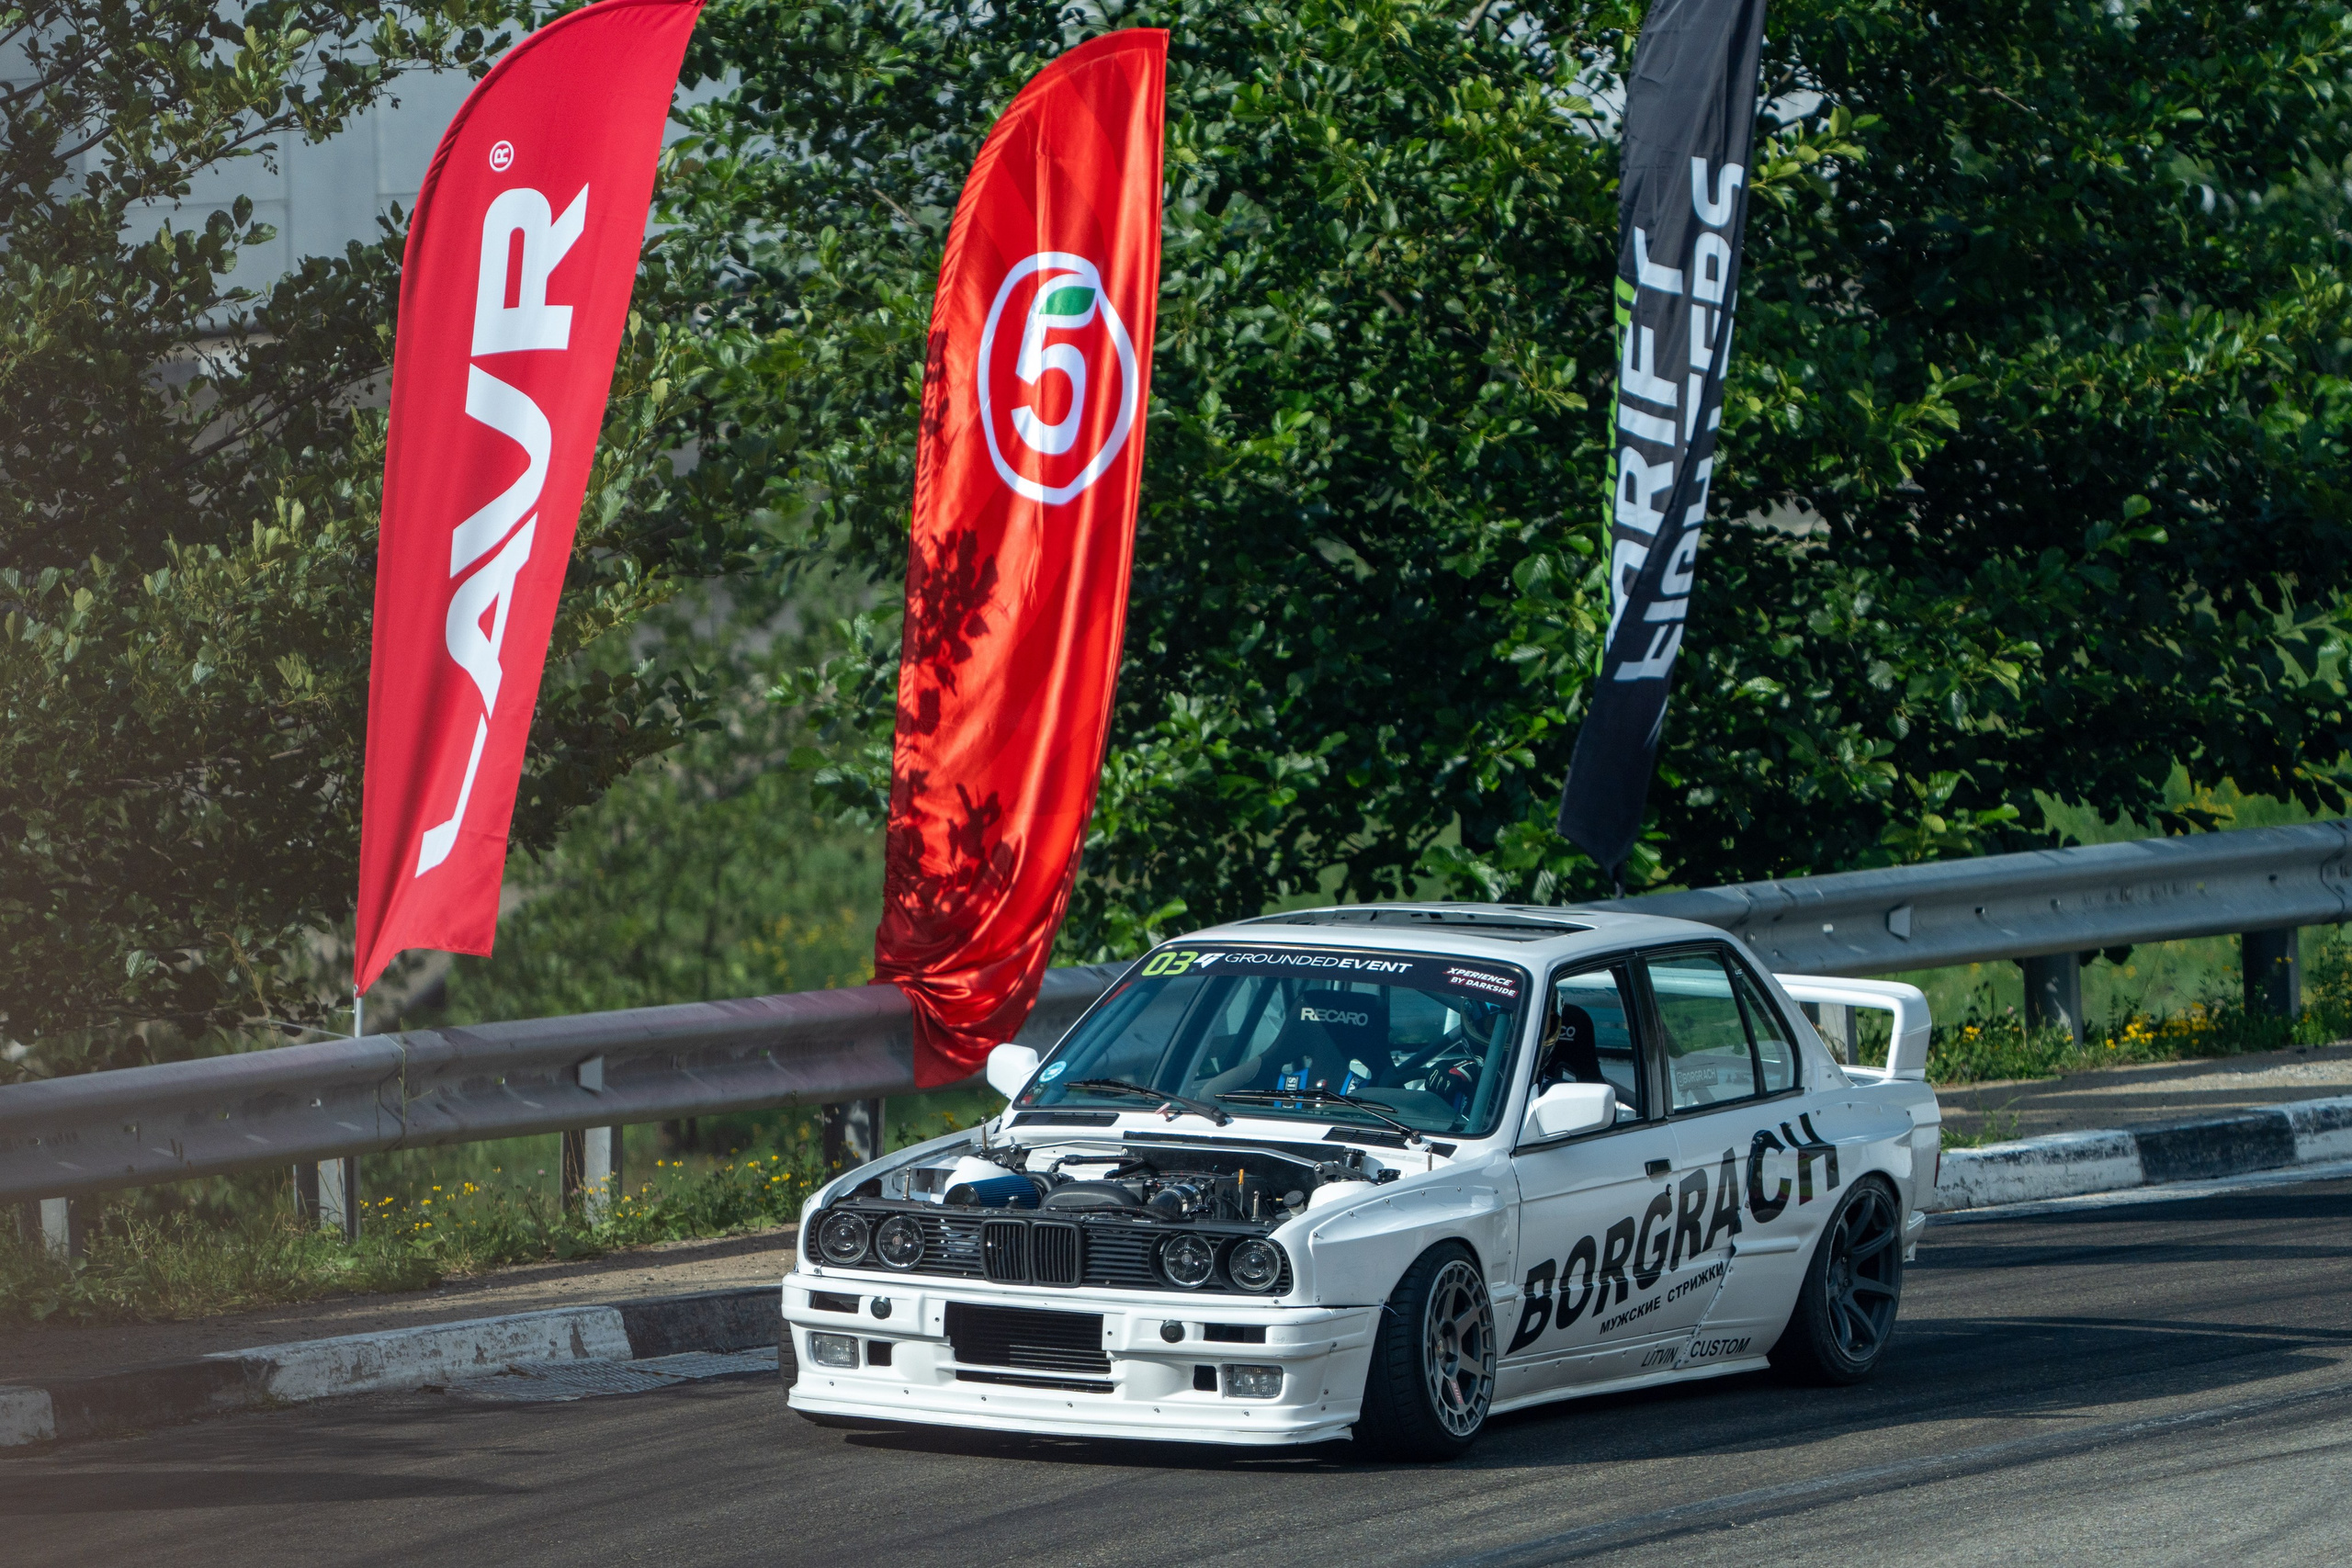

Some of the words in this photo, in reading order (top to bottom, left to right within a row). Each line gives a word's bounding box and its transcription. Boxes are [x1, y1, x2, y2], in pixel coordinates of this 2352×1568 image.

[1447, 967, 1513, 986] XPERIENCE
[1465, 979, 1516, 997] DARKSIDE
[1300, 1007, 1369, 1027] RECARO
[1505, 1111, 1840, 1355] BORGRACH
[1600, 1295, 1661, 1335] МУЖСКИЕ
[1667, 1260, 1724, 1303] СТРИЖКИ
[1641, 1347, 1679, 1367] LITVIN
[1690, 1337, 1751, 1358] CUSTOM
